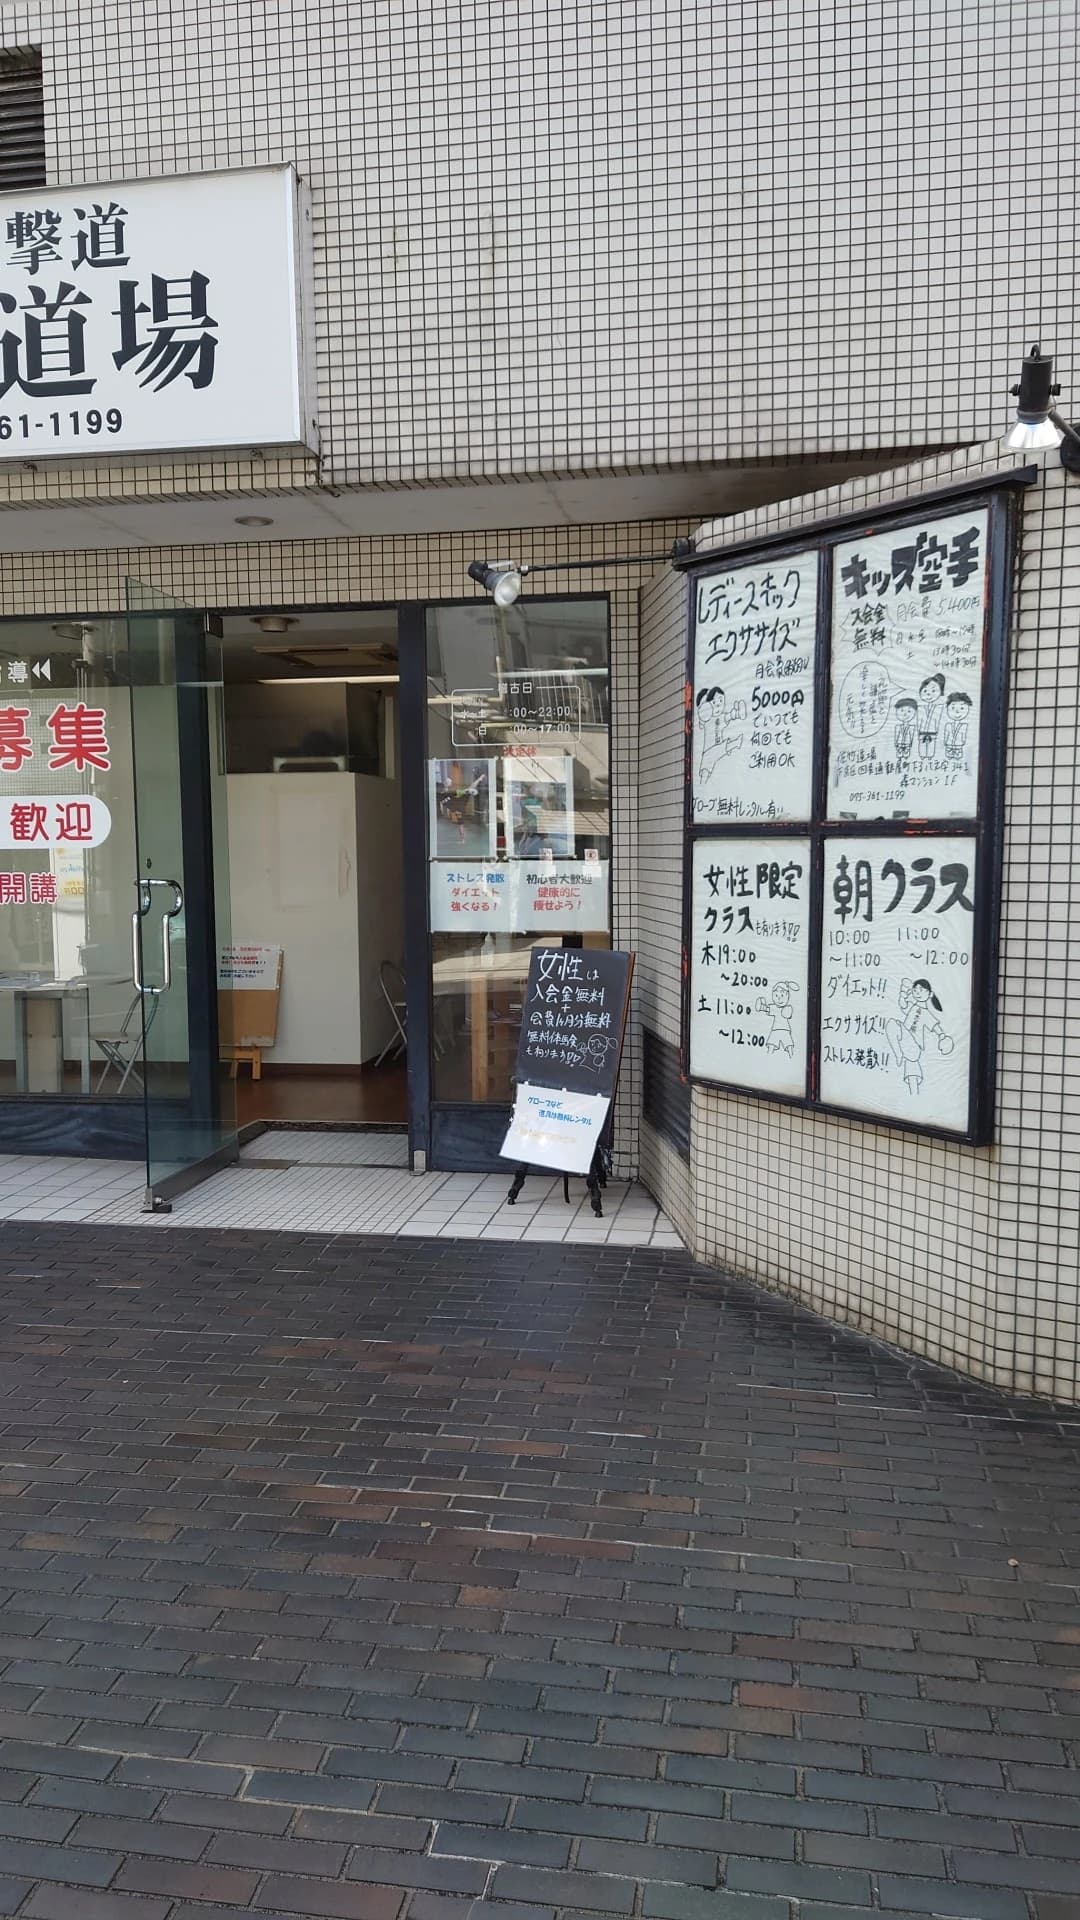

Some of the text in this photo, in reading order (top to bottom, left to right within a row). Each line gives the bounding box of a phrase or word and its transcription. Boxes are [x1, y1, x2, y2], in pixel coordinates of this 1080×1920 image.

[5, 202, 130, 275] 撃道
[0, 270, 218, 399] 道場
[841, 526, 980, 599] キッズ空手
[704, 617, 800, 664] エクササイズ
[751, 686, 804, 711] 5000円
[750, 730, 792, 747] 何回でも
[10, 802, 93, 842] 歓迎
[0, 872, 57, 904] 開講
[526, 873, 593, 884] 初心者大歓迎
[538, 887, 580, 898] 健康的に
[703, 861, 802, 899] 女性限定
[833, 855, 975, 925] 朝クラス
[704, 906, 754, 934] クラス
[829, 927, 939, 946] 10:00 11:00
[537, 949, 600, 982] 女性は
[531, 983, 604, 1006] 入会金無料
[527, 1030, 577, 1048] 無料体験
